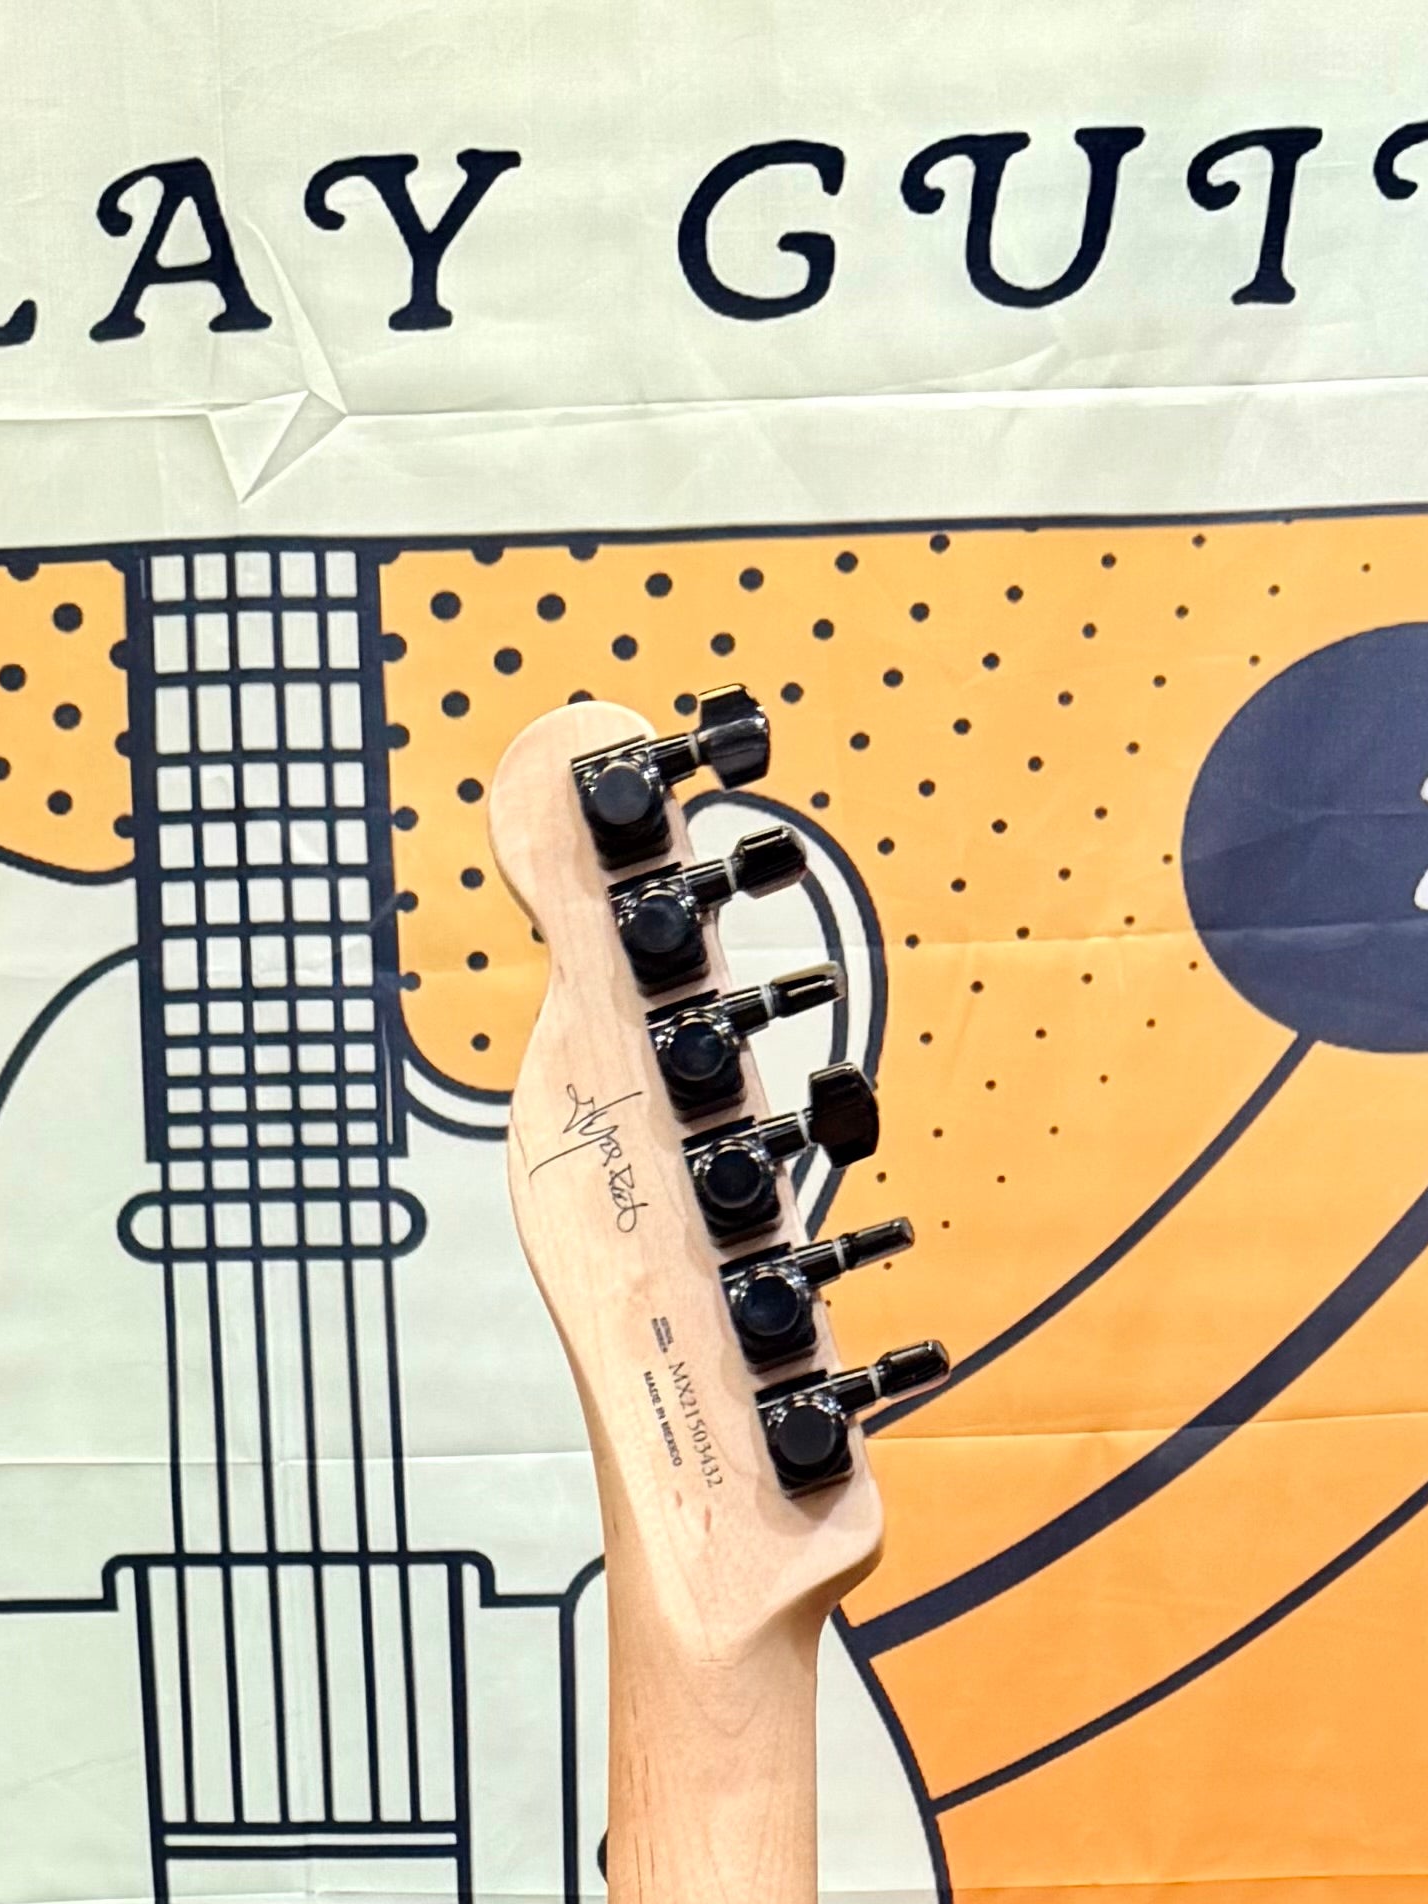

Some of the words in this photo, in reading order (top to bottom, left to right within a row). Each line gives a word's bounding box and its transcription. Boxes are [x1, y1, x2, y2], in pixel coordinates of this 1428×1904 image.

[644, 1371, 661, 1405] MADE
[656, 1406, 665, 1420] IN
[661, 1421, 682, 1467] MEXICO
[668, 1361, 723, 1488] MX21503432
